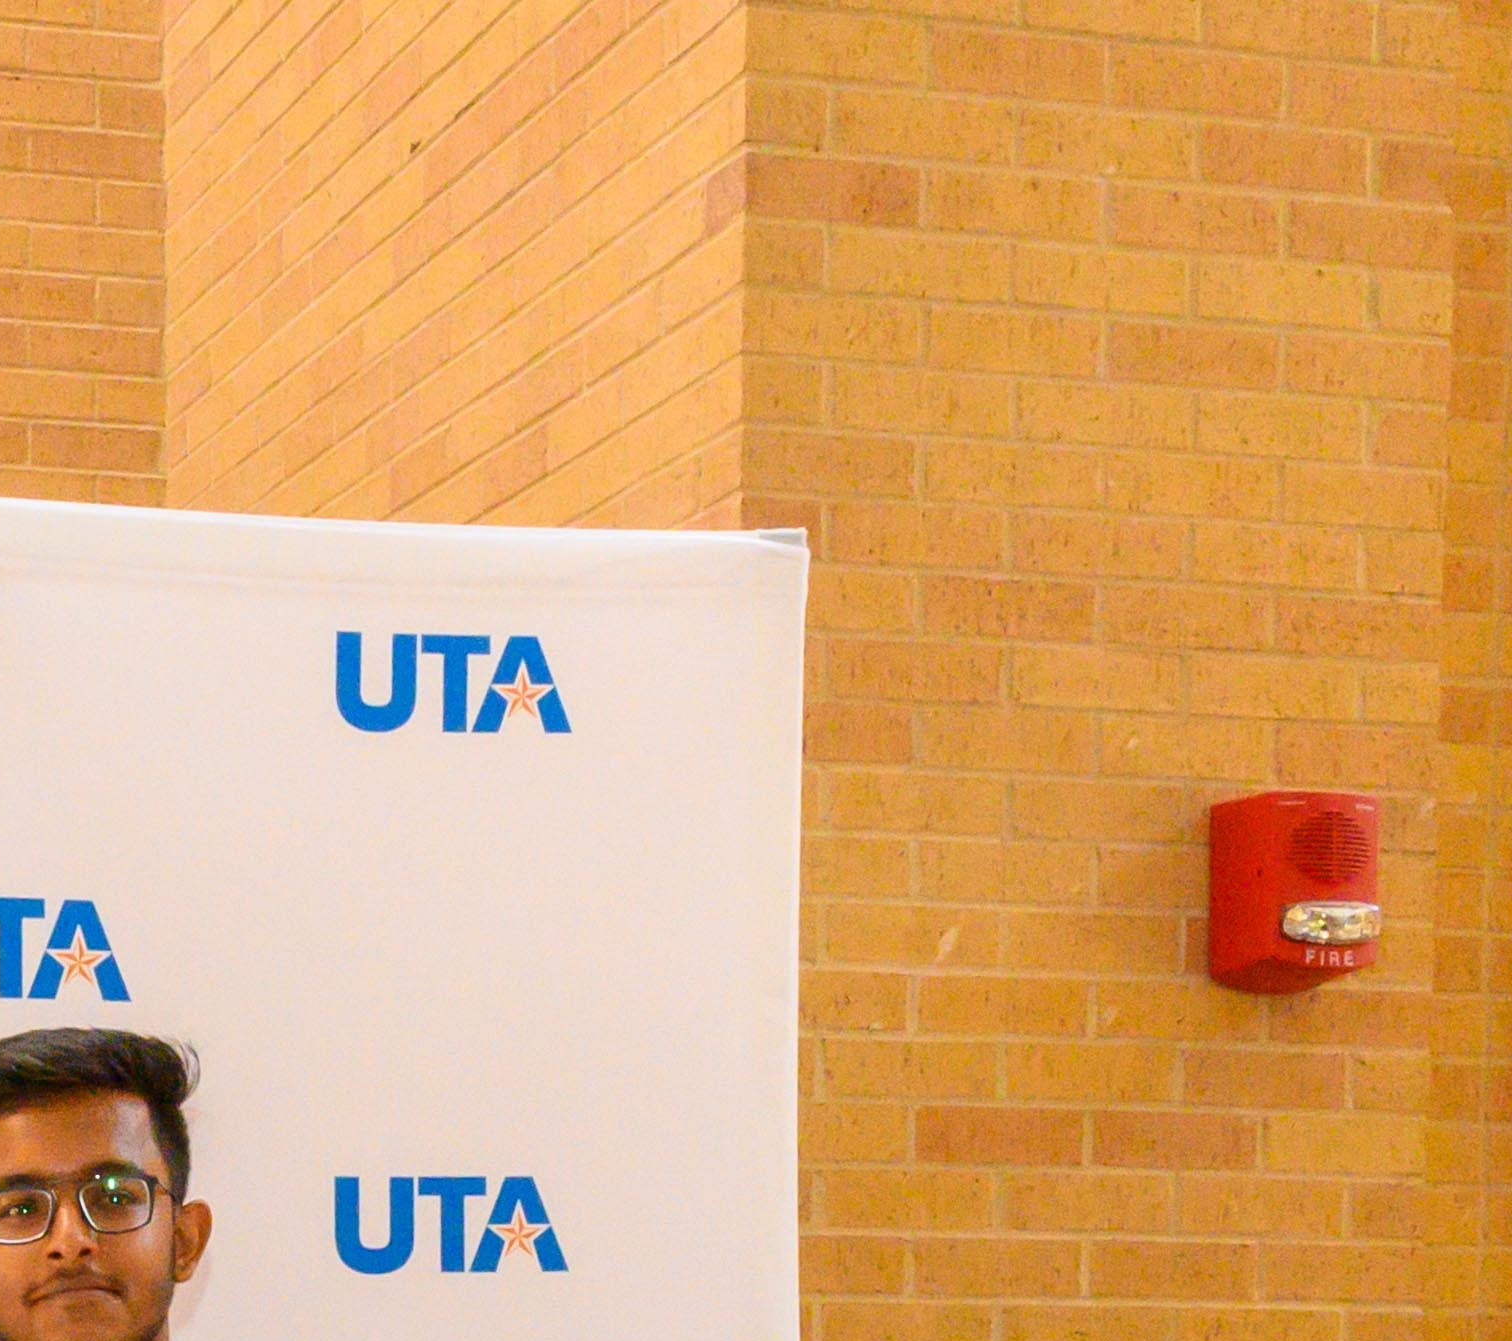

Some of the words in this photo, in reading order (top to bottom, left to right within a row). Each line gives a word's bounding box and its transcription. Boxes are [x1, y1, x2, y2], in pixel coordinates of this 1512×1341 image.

[336, 631, 573, 734] UTA
[1304, 948, 1355, 967] FIRE
[334, 1176, 569, 1275] UTA
